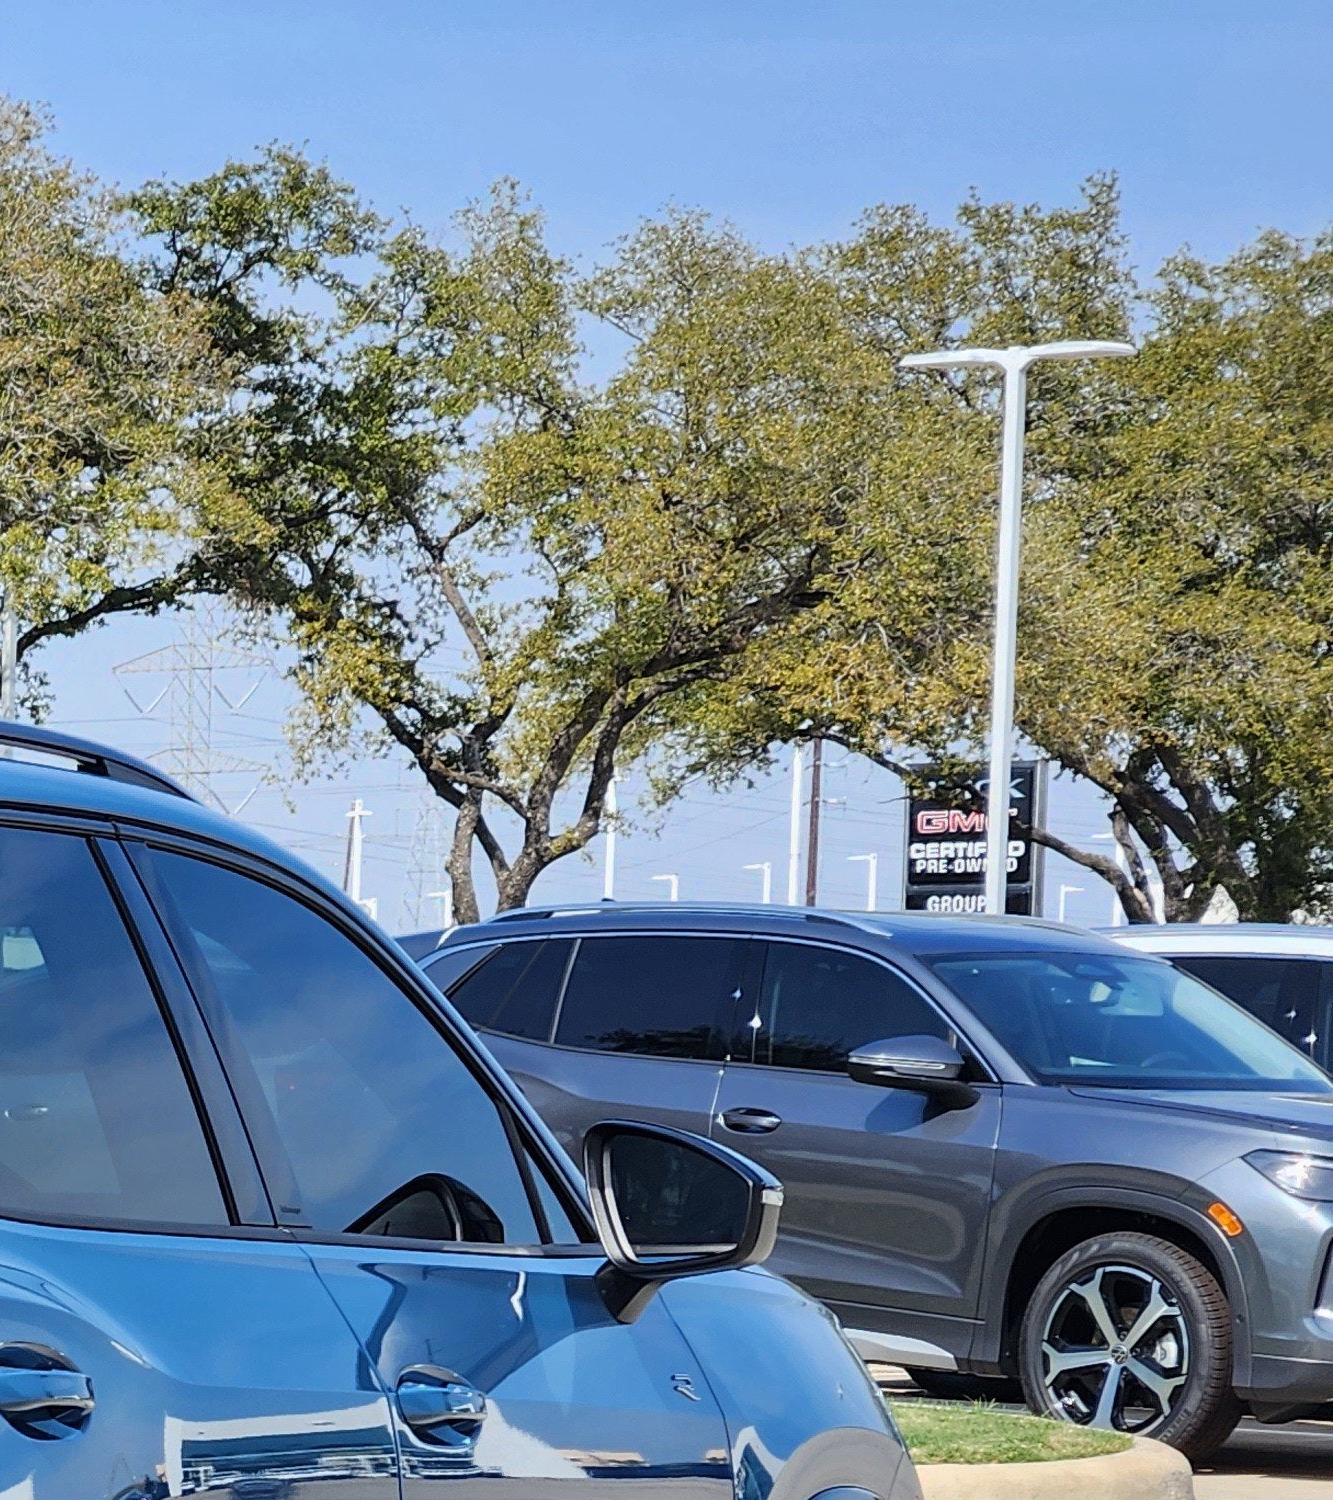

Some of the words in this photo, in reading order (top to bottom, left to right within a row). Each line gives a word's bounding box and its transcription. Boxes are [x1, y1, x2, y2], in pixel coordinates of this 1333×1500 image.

[917, 809, 1018, 833] GM
[909, 841, 1026, 859] CERTIFD
[915, 858, 1018, 874] PRE-OWD
